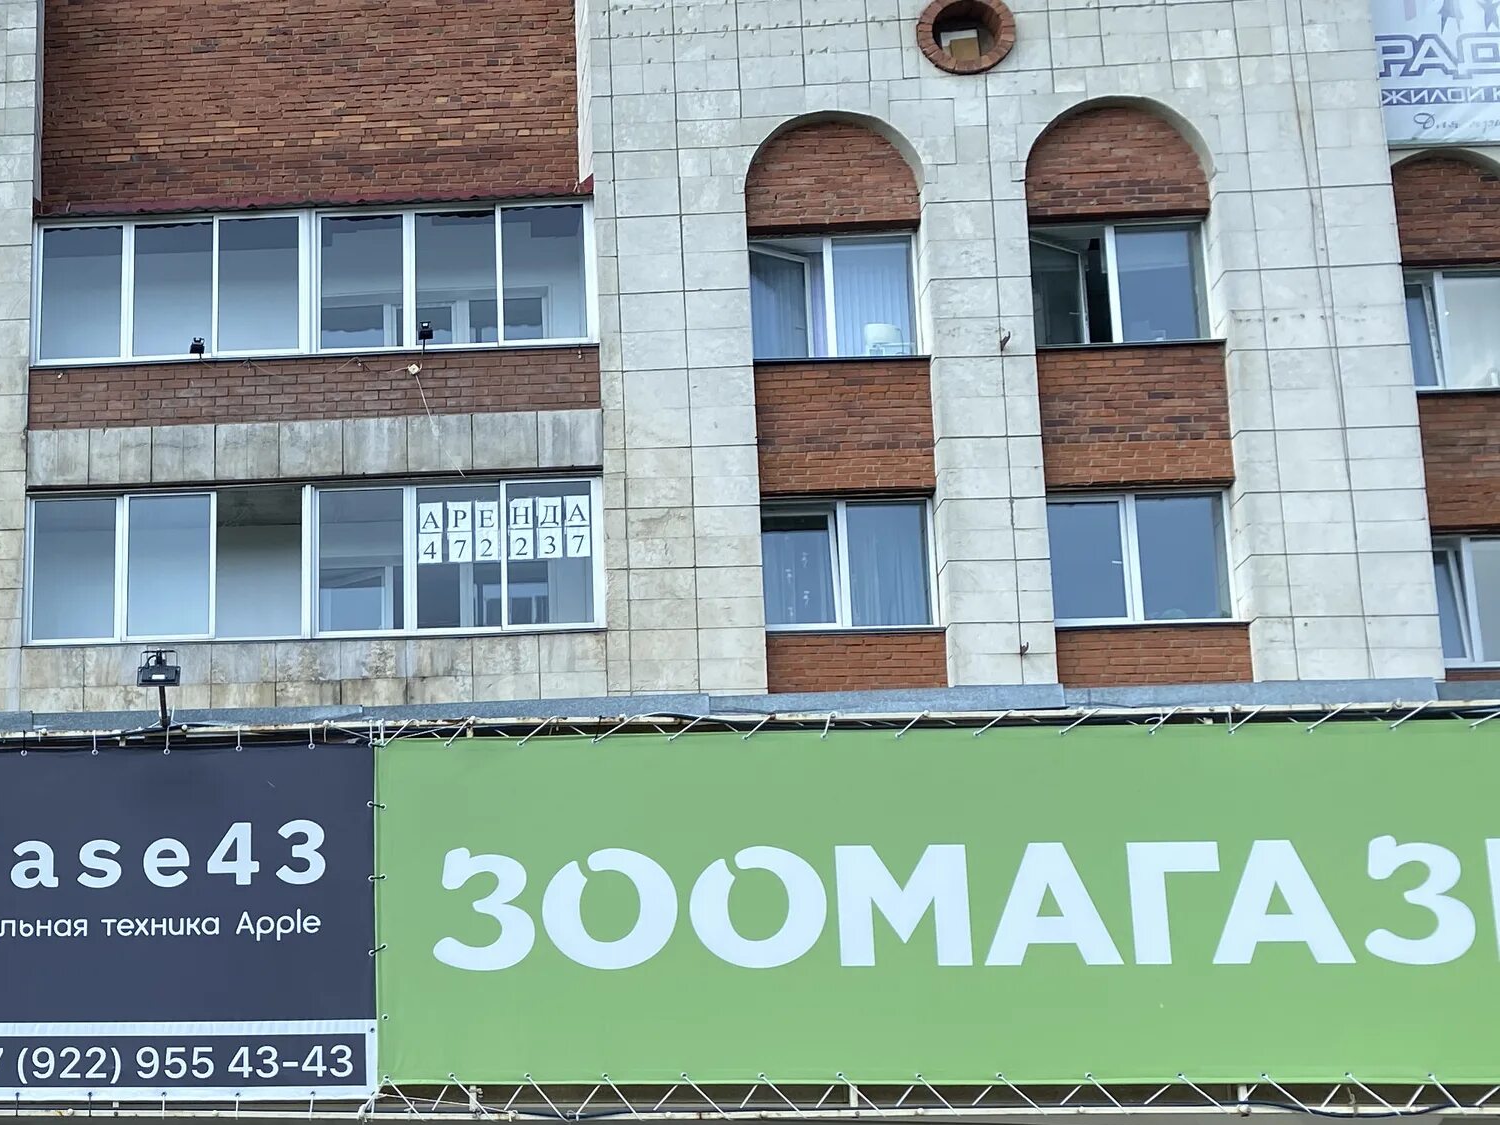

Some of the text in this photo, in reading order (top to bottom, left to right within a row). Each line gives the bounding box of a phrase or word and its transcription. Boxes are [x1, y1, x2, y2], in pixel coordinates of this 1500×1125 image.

[421, 503, 589, 530] АРЕНДА
[423, 535, 584, 559] 472237
[433, 834, 1500, 971] ЗООМАГАЗ
[101, 913, 220, 937] техника
[236, 908, 321, 942] Apple
[16, 1045, 123, 1084] (922)
[135, 1046, 214, 1078] 955
[227, 1044, 354, 1077] 43-43
